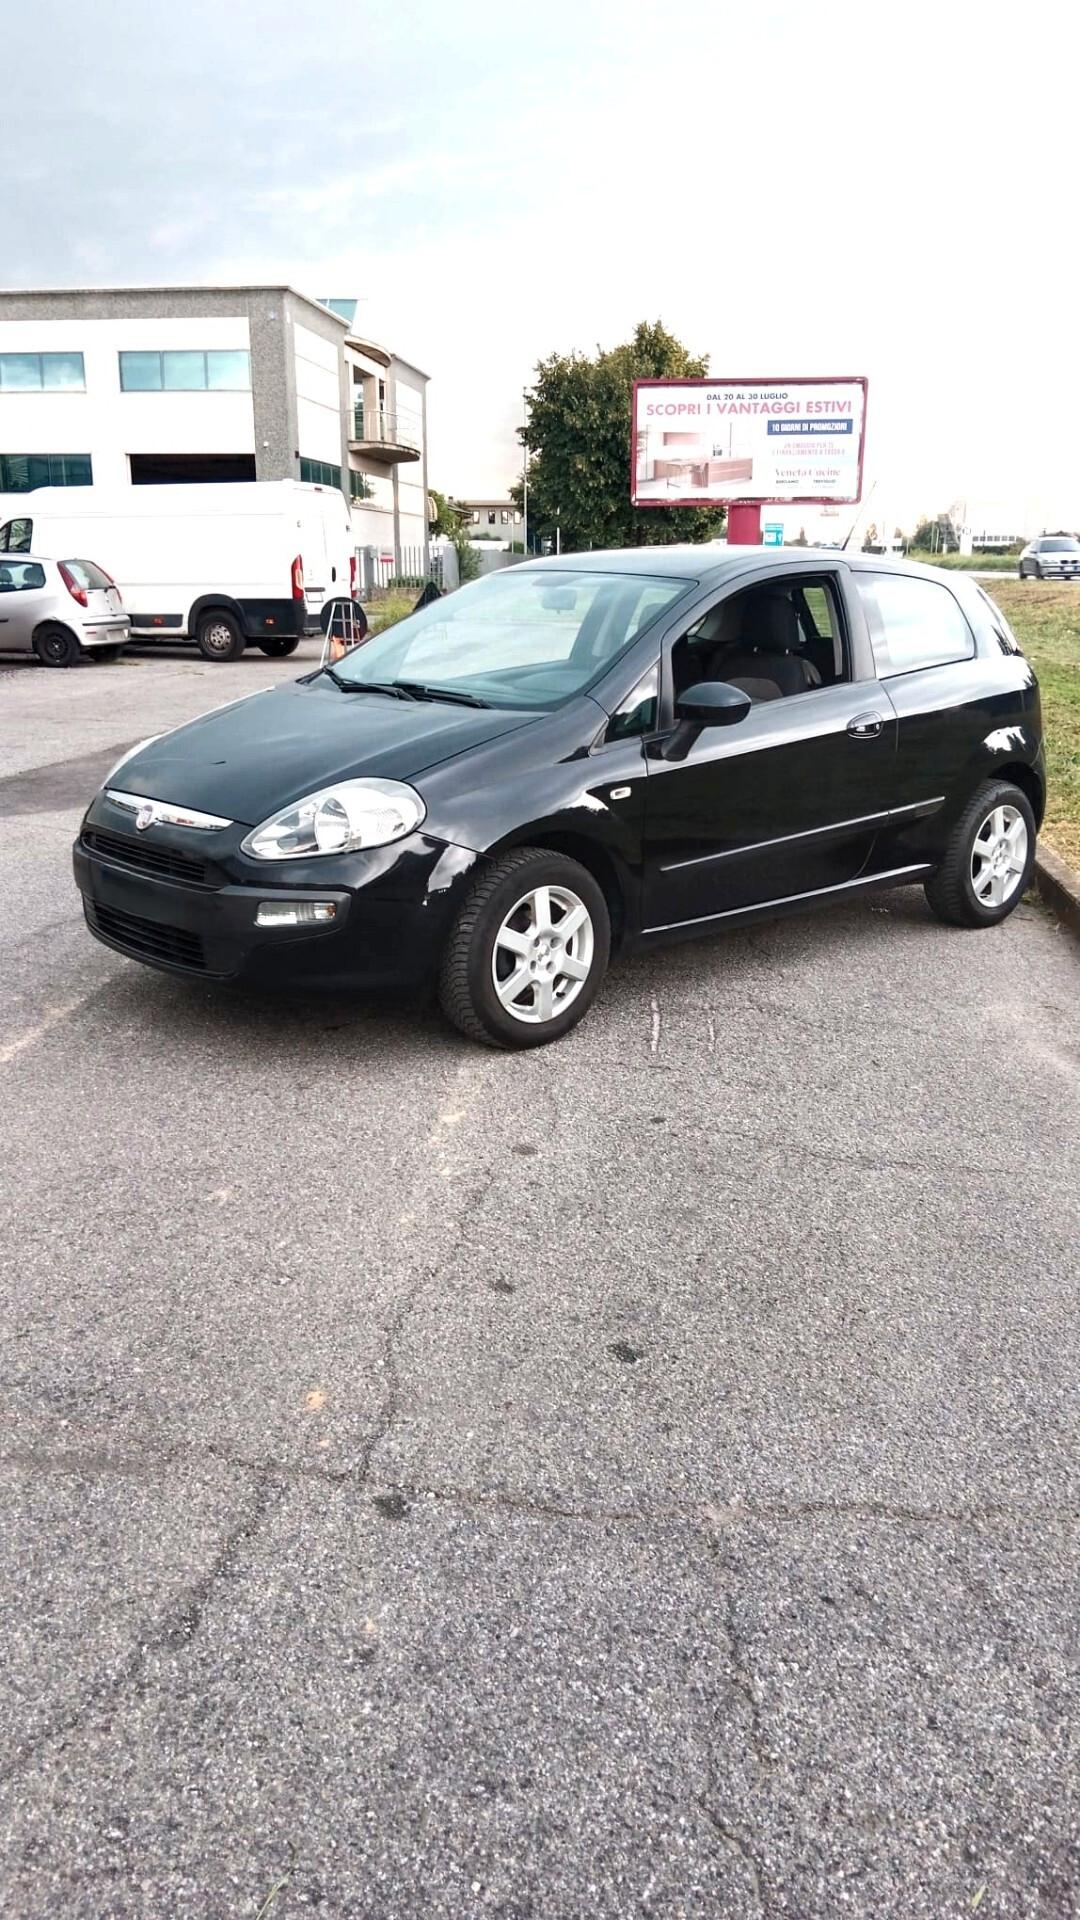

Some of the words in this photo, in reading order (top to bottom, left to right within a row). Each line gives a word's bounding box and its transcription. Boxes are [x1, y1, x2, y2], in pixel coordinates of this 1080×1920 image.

[706, 393, 721, 401] DAL
[724, 393, 734, 401] 20
[736, 393, 746, 401] AL
[760, 392, 789, 400] LUGLIO
[646, 403, 701, 416] SCOPRI
[706, 403, 711, 415] I
[716, 401, 801, 415] VANTAGGI
[806, 400, 852, 413] ESTIVI
[772, 423, 780, 432] 10
